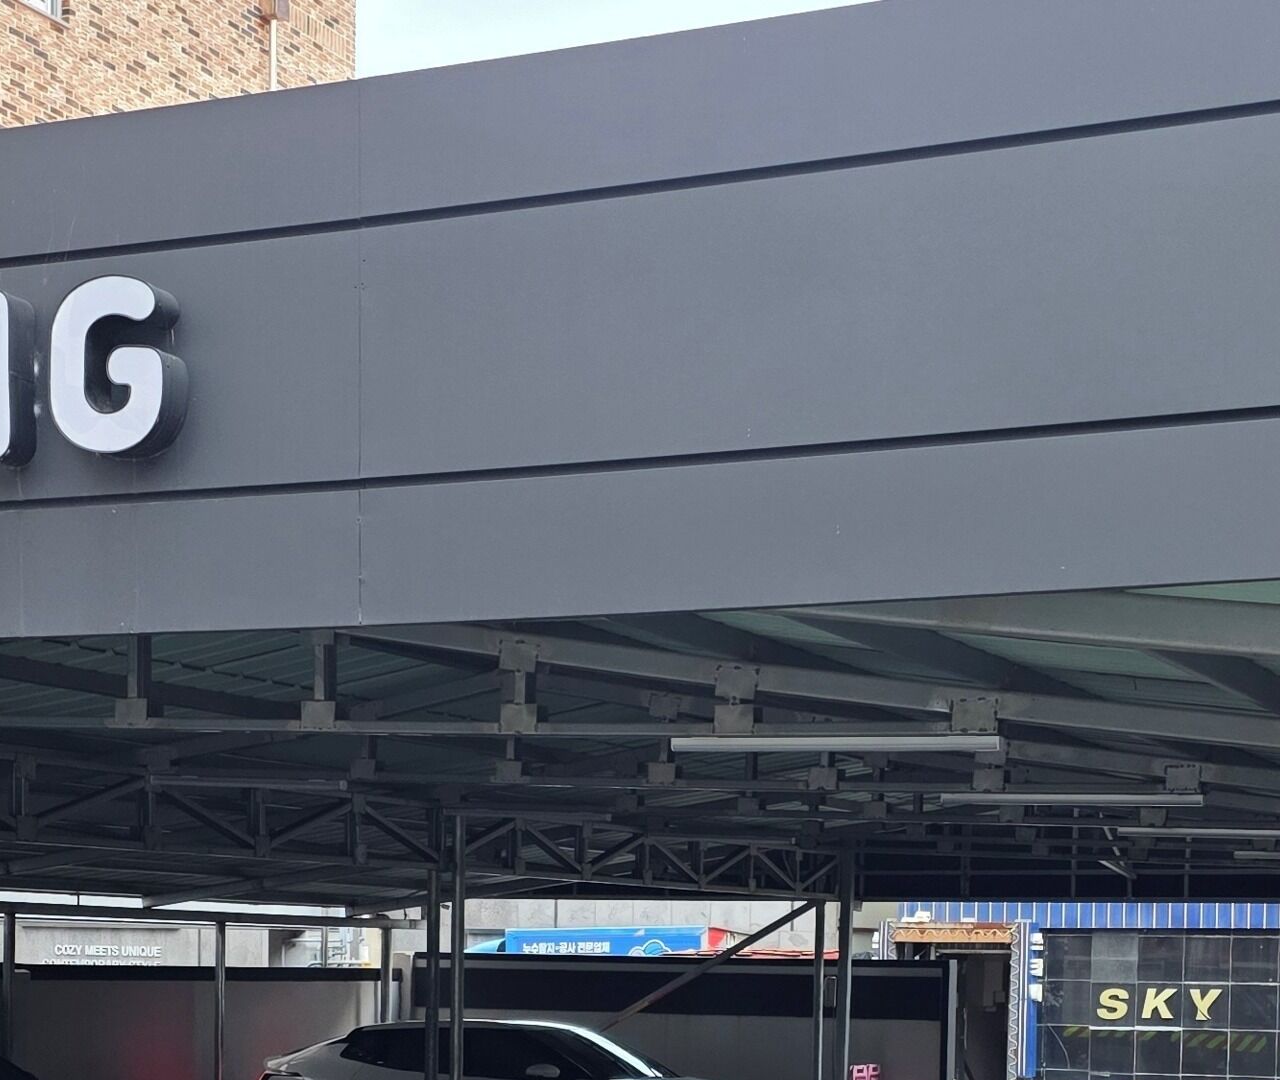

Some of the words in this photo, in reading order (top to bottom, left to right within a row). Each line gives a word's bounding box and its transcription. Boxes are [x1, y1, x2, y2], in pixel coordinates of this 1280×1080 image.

[54, 944, 82, 956] COZY
[84, 945, 120, 957] MEETS
[121, 946, 161, 958] UNIQUE
[1096, 987, 1223, 1021] SKY
